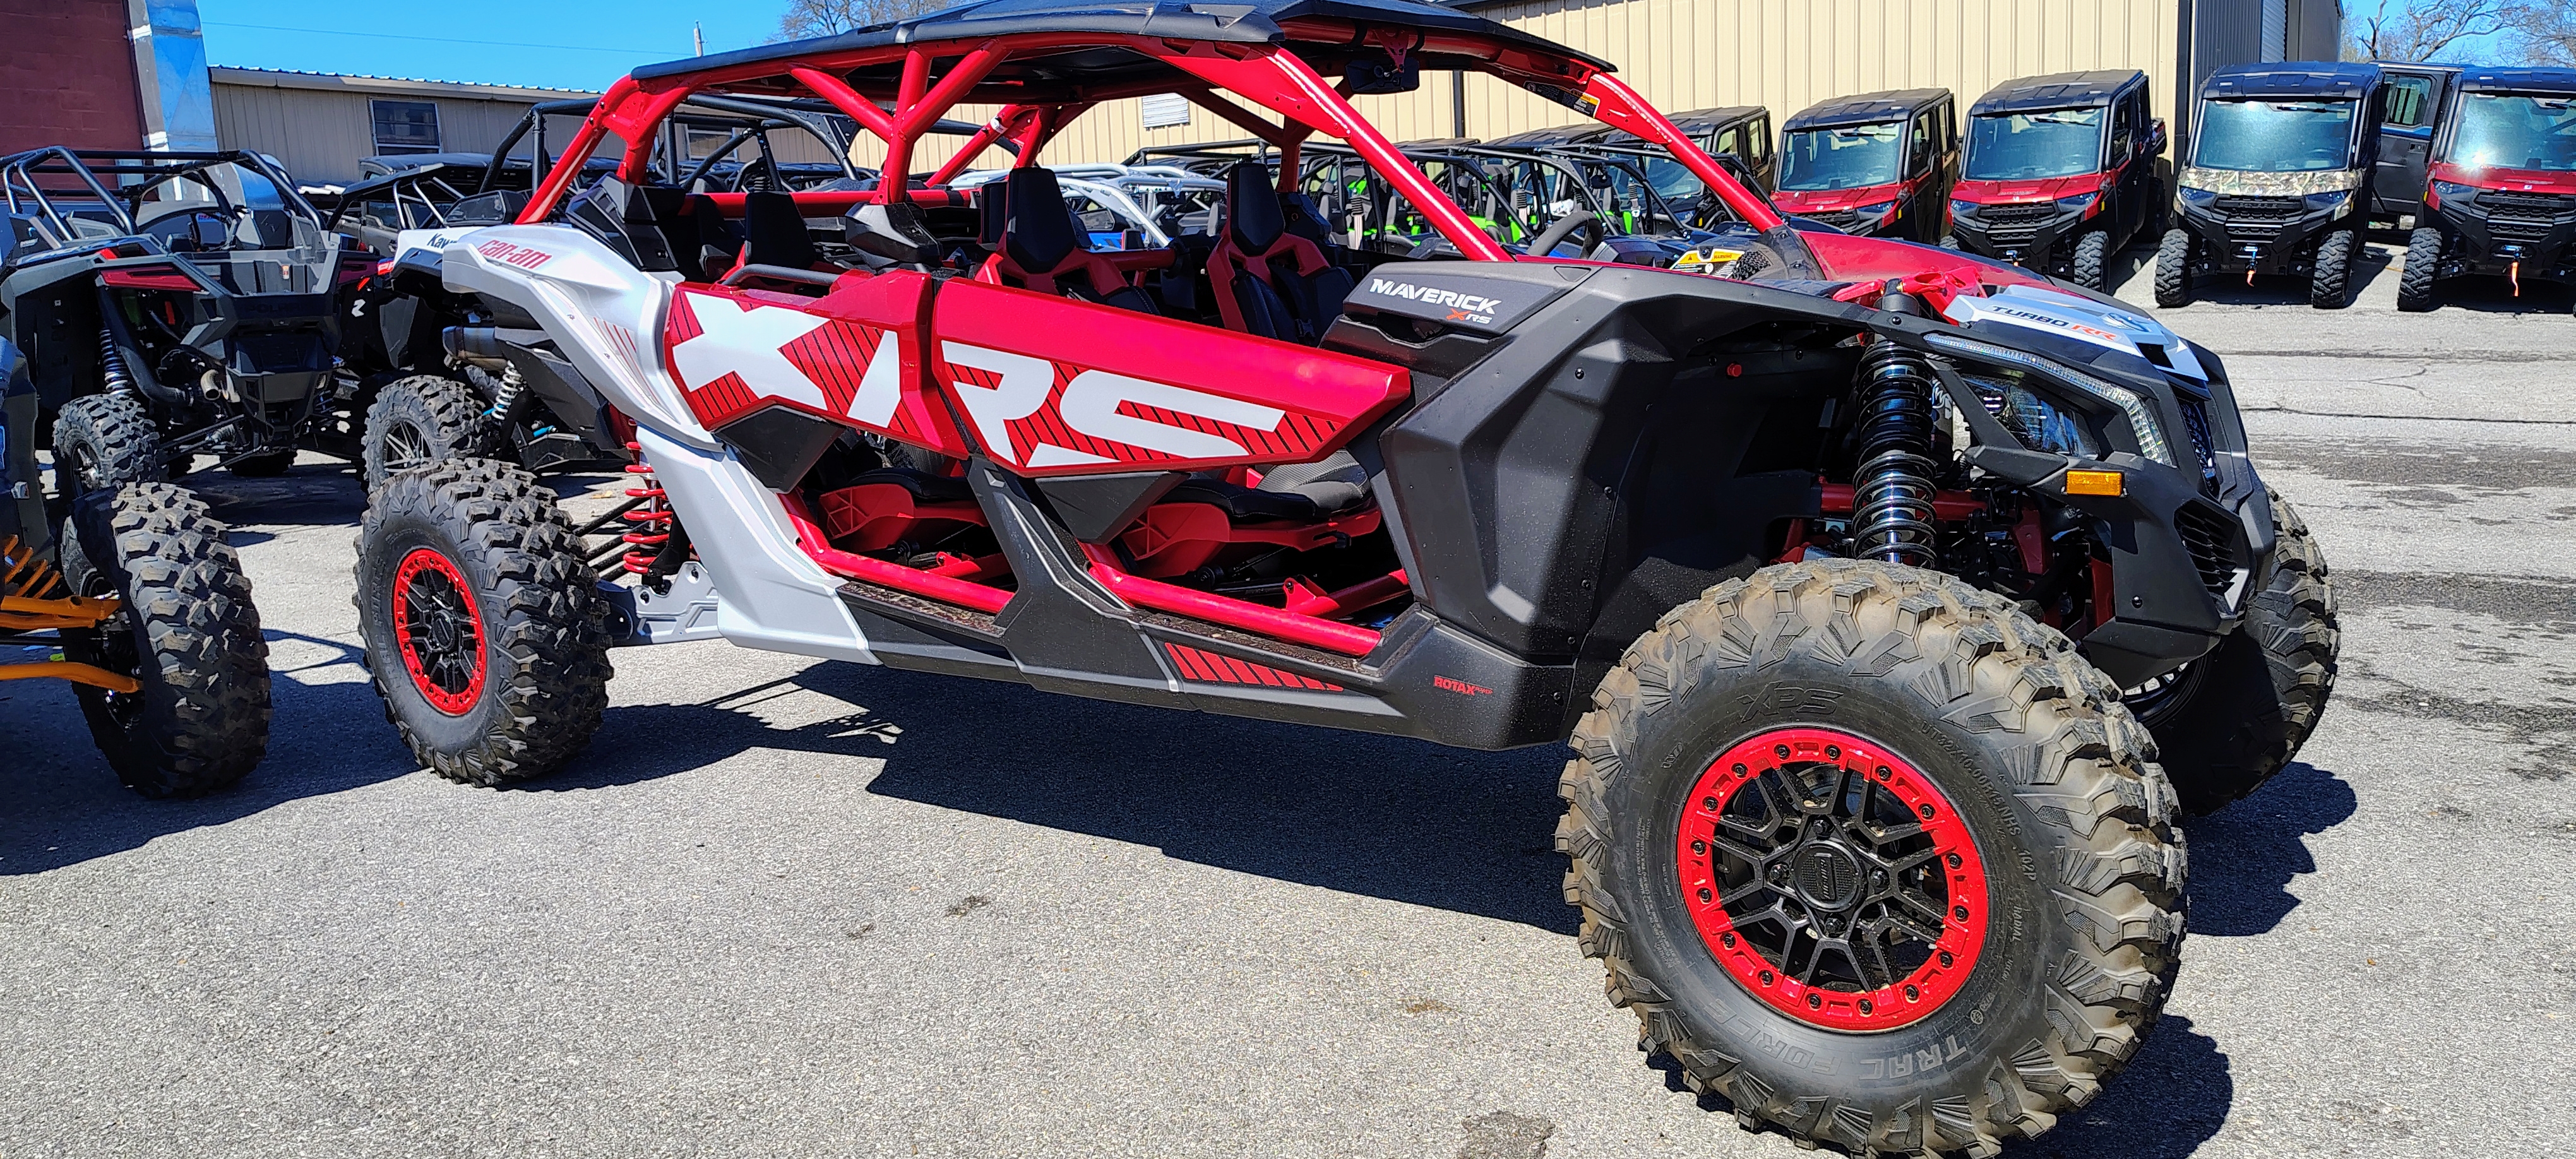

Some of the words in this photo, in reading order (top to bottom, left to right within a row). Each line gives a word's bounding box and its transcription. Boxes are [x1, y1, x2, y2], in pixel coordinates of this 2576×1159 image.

[477, 239, 552, 270] can-am
[1369, 278, 1502, 315] MAVERICK
[1445, 308, 1493, 324] XRS
[1992, 306, 2069, 328] TURBO
[2070, 324, 2117, 342] RR
[1433, 675, 1476, 696] ROTAX
[1736, 680, 1844, 723] XPS
[1998, 806, 2022, 836] NHS
[2018, 849, 2037, 881] 102P
[2012, 905, 2023, 942] RADIAL
[1705, 997, 1844, 1077] FORCE
[1859, 1035, 1968, 1081] TRAC
